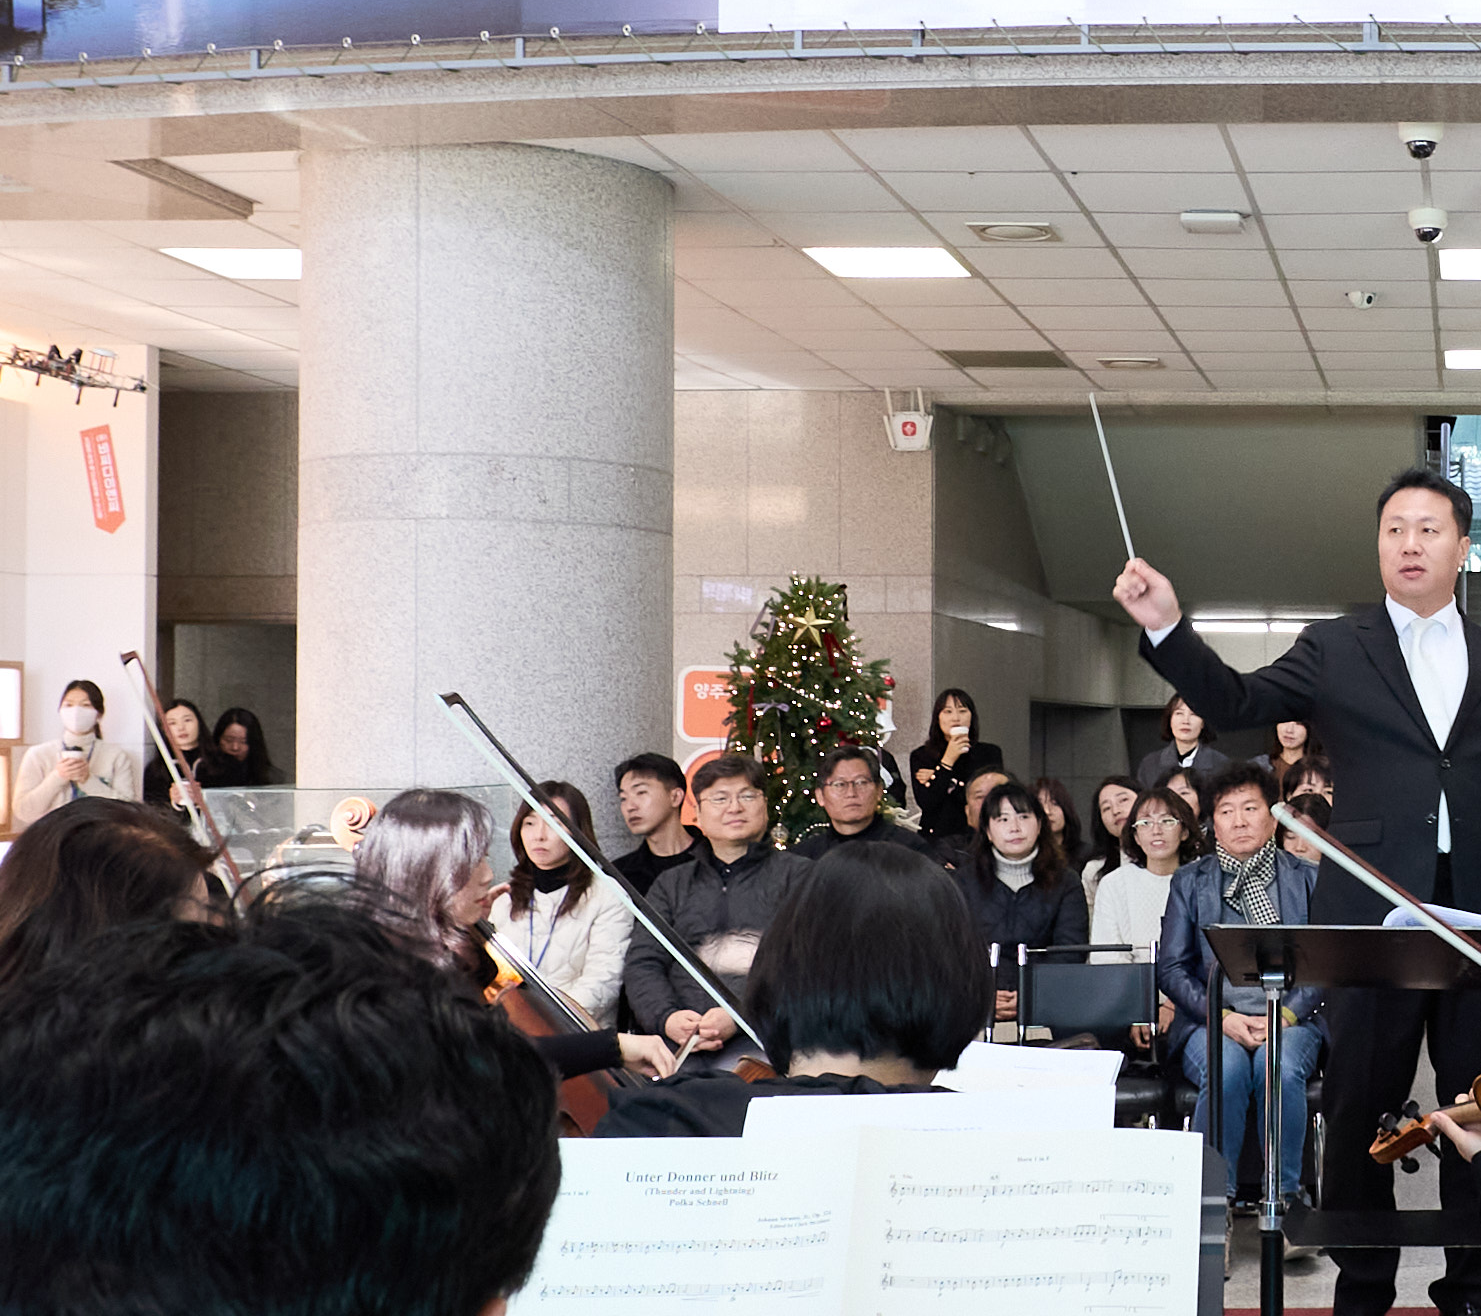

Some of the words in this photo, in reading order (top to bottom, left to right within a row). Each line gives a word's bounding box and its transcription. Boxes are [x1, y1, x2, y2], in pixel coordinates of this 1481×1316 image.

[625, 1171, 663, 1183] Unter
[667, 1171, 716, 1183] Donner
[720, 1170, 745, 1182] und
[749, 1170, 779, 1182] Blitz
[644, 1187, 686, 1197] (Thunder
[690, 1187, 706, 1196] and
[709, 1187, 755, 1197] Lightning)
[669, 1198, 694, 1207] Polka
[697, 1198, 728, 1207] Schnell
